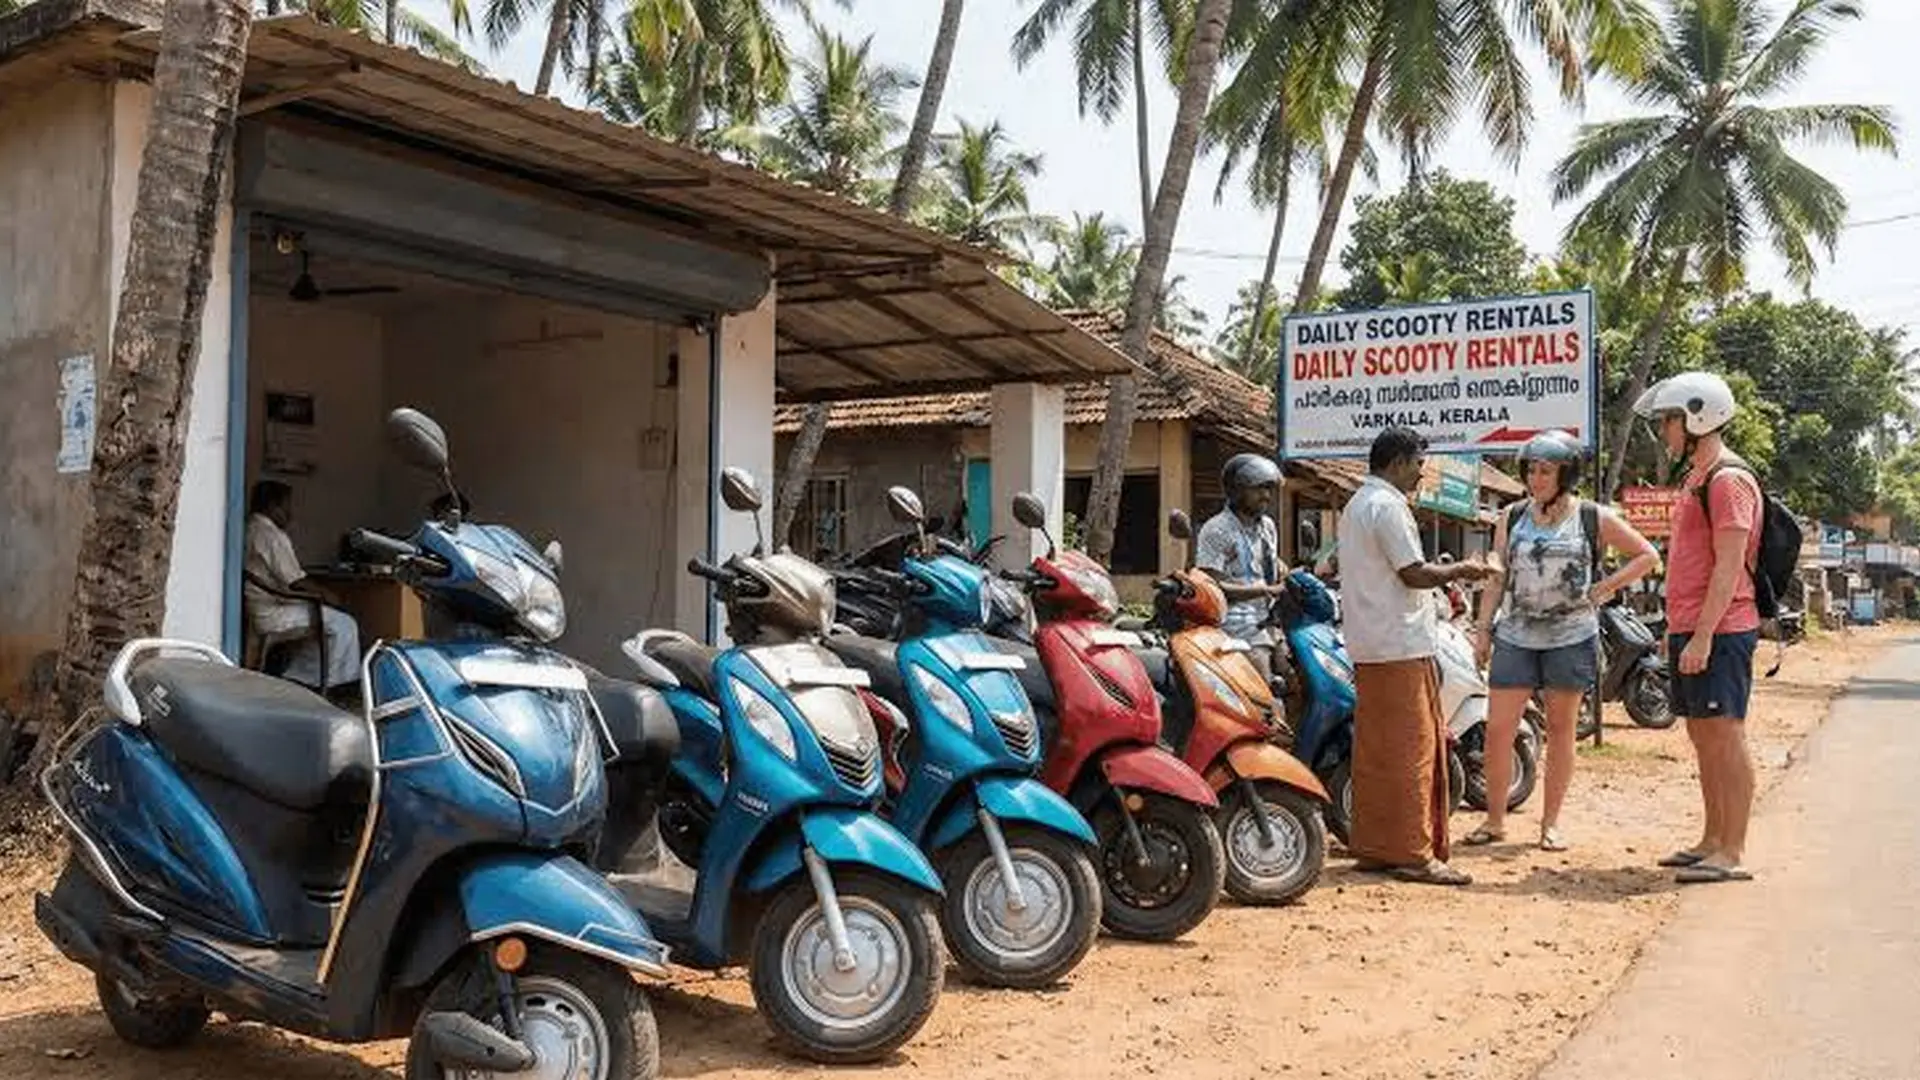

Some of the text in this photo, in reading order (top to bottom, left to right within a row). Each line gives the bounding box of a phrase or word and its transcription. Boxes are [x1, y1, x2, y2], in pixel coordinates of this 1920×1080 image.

[1298, 302, 1575, 344] DAILY SCOOTY RENTALS
[1293, 332, 1580, 381] DAILY SCOOTY RENTALS
[1351, 407, 1510, 428] VARKALA, KERALA
